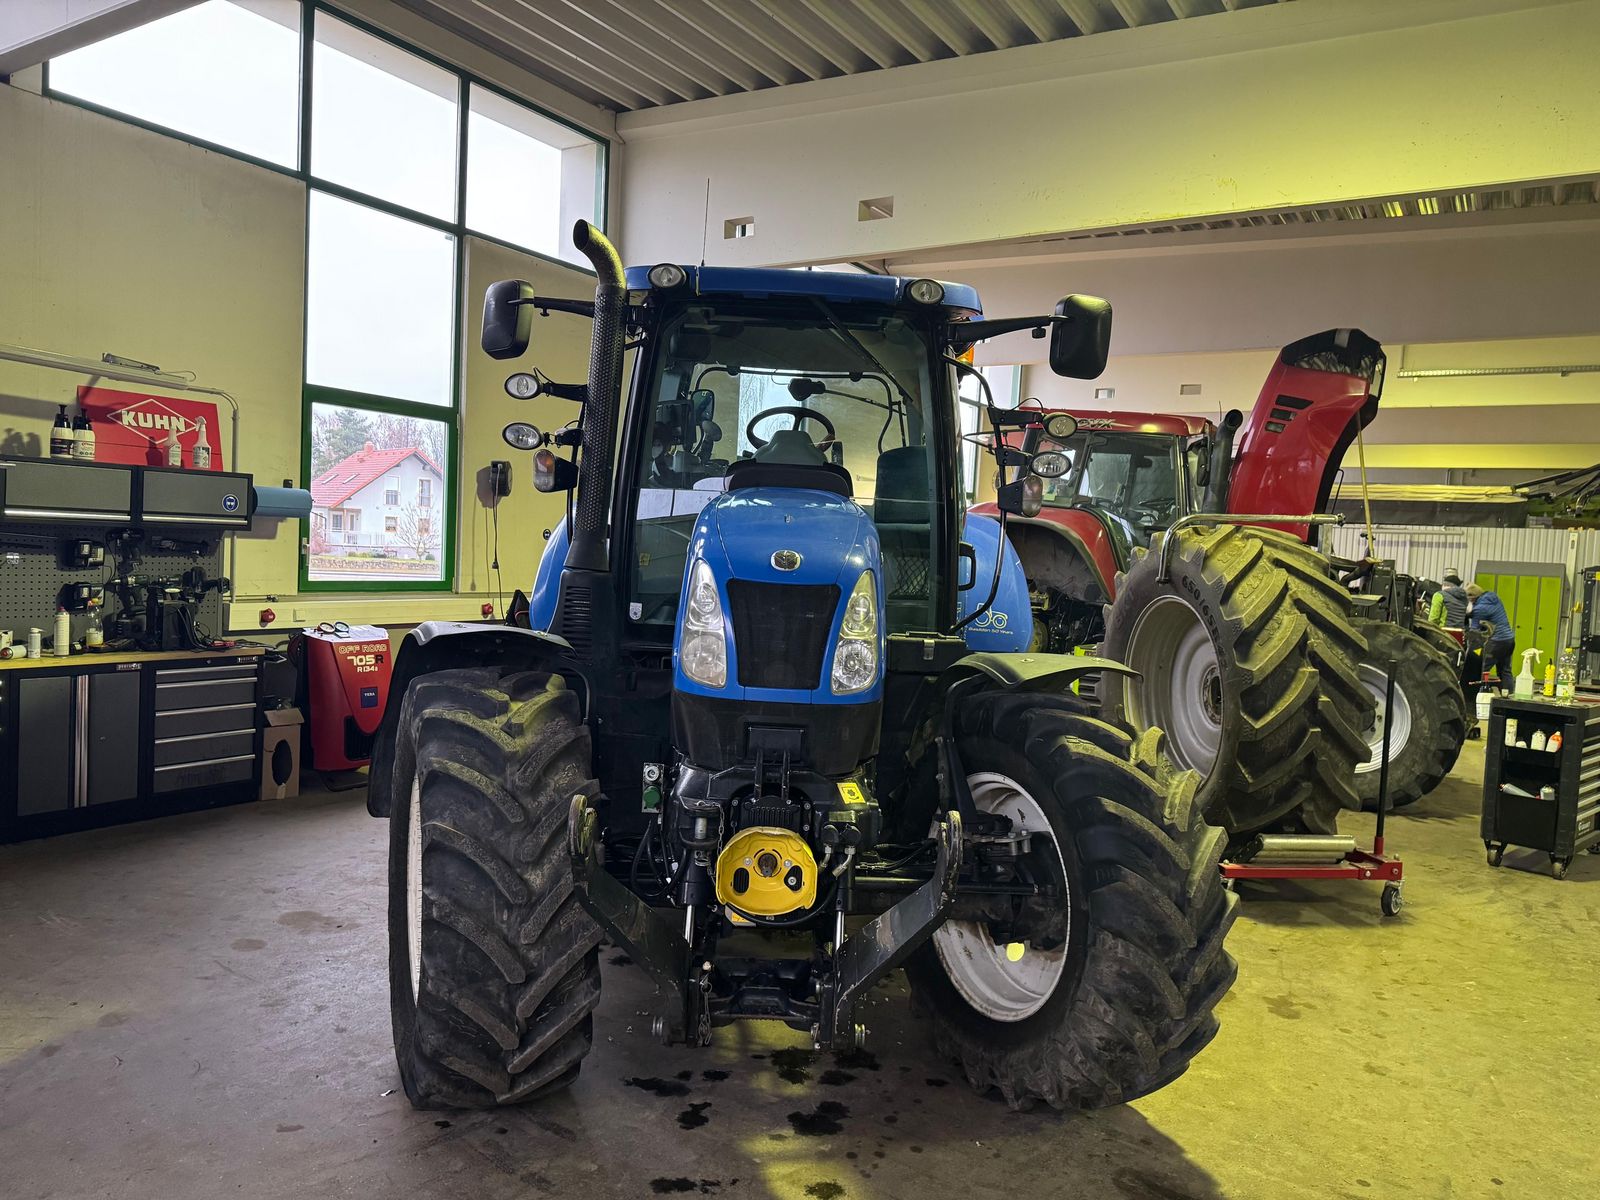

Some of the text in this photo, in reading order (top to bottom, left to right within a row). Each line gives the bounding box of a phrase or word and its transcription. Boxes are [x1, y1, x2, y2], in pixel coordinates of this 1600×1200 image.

[121, 410, 186, 432] KUHN
[339, 644, 387, 654] OFF ROAD
[347, 654, 384, 666] 705R
